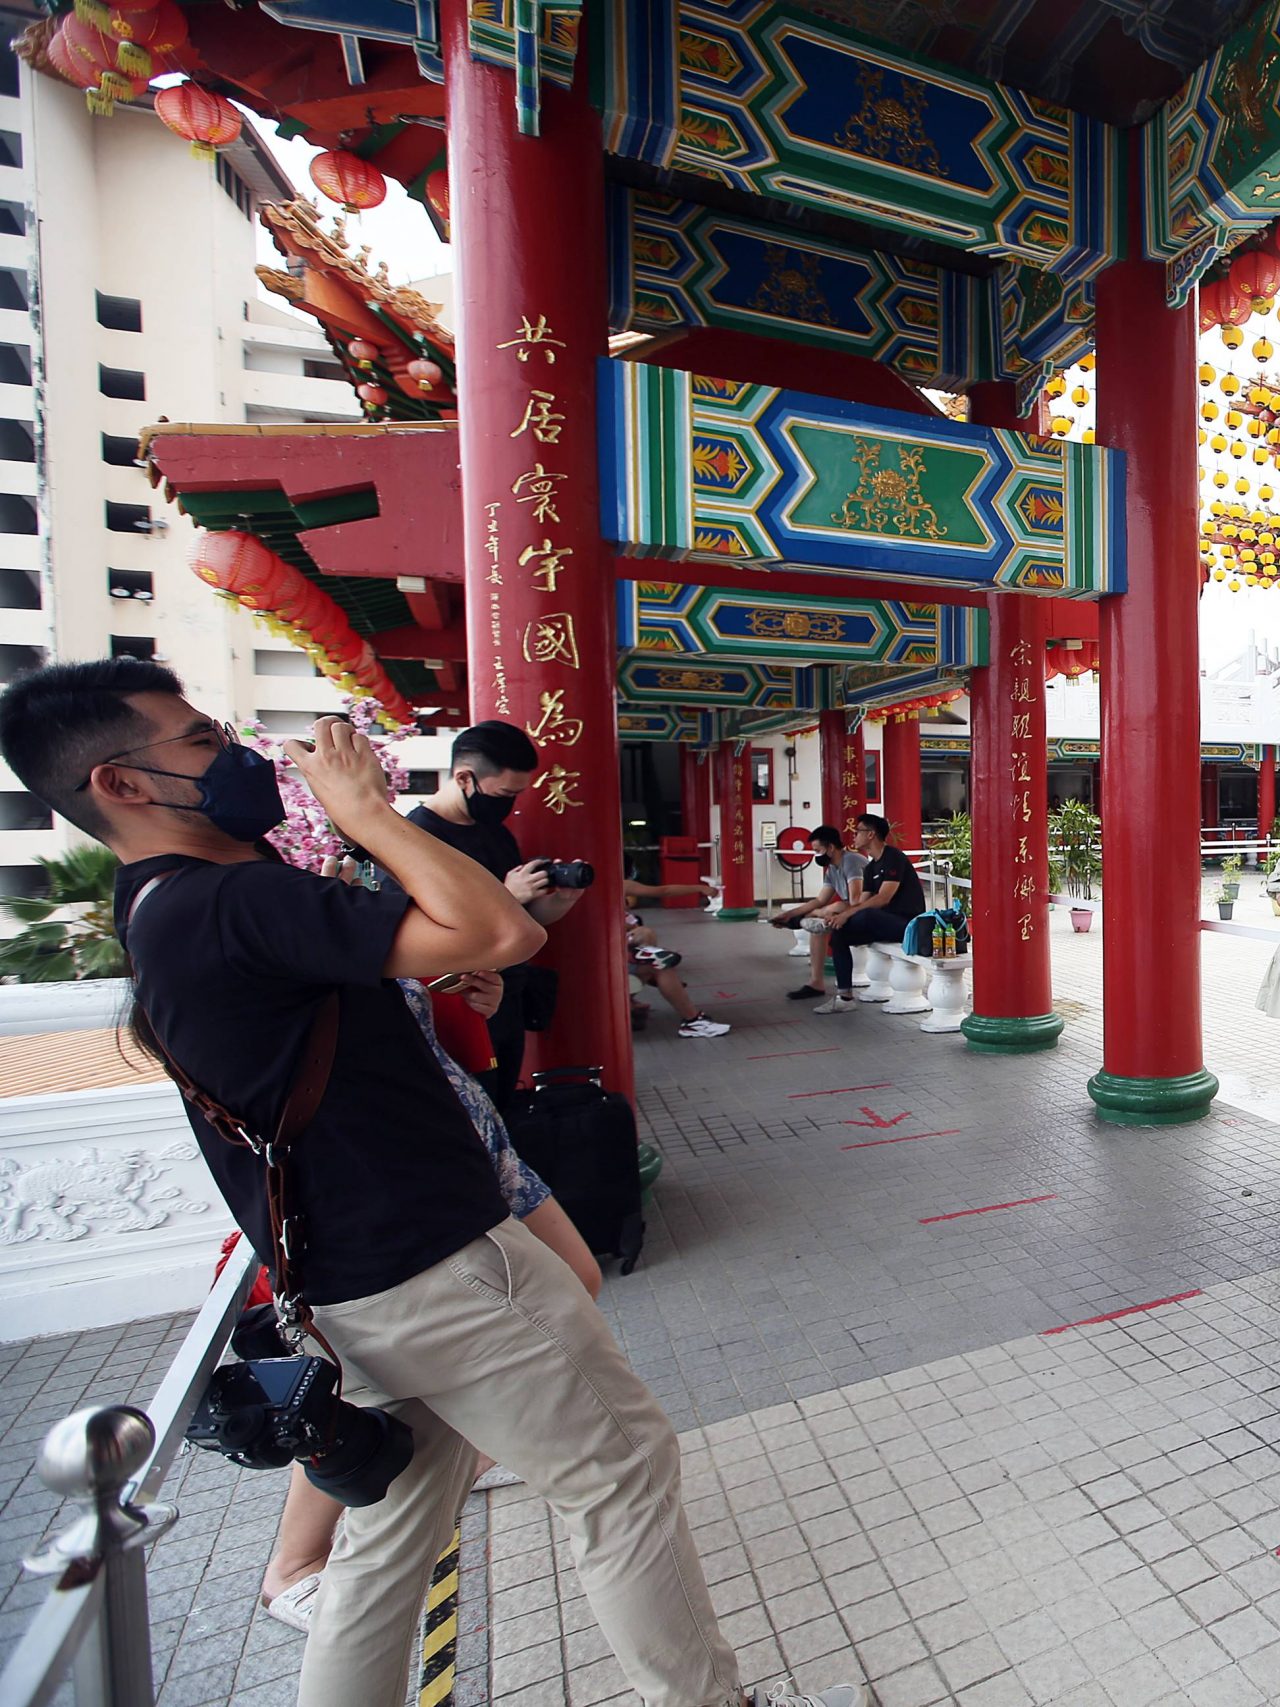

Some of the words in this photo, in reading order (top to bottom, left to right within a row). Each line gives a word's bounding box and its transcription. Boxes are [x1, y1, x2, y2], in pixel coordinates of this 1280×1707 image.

[496, 314, 585, 814] 共居寰宇國為家
